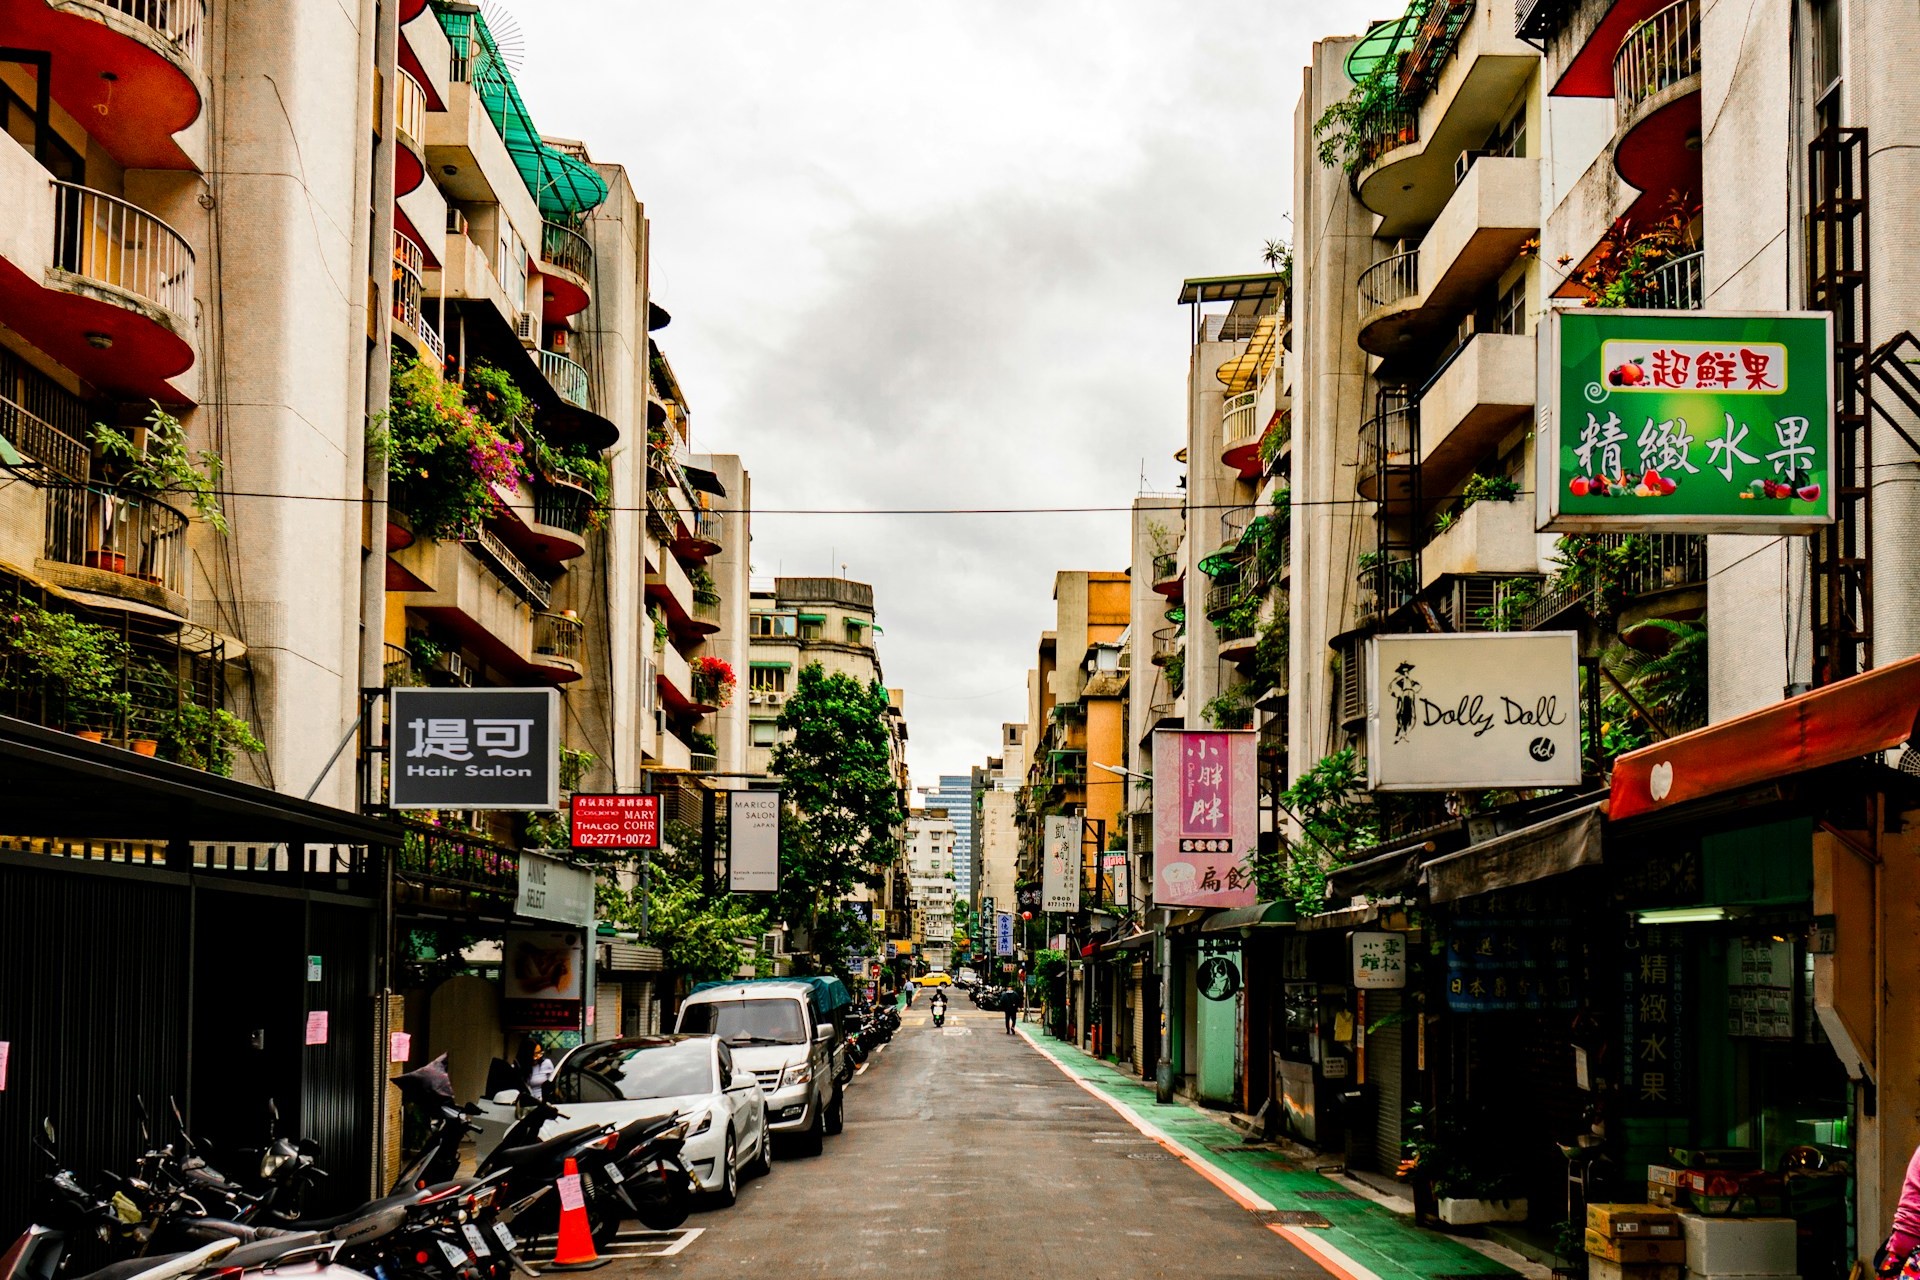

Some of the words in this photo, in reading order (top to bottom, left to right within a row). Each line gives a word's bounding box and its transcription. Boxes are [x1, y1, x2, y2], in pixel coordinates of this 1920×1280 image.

[1651, 348, 1778, 391] 超鮮果
[1571, 411, 1817, 484] 精緻水果
[1419, 696, 1495, 737] Dolly
[1504, 694, 1567, 726] Doll
[406, 717, 535, 762] 提可
[407, 764, 458, 778] Hair
[464, 764, 532, 778] Salon
[1187, 738, 1225, 829] 小胖胖
[624, 810, 656, 820] MARY
[735, 801, 776, 809] MARICO
[745, 811, 776, 819] SALON
[623, 821, 655, 830] COHR
[580, 833, 652, 845] 02-2771-0072
[1200, 866, 1246, 893] 扁食
[1640, 953, 1668, 1103] 精緻水果
[347, 1225, 378, 1240] KYMCO
